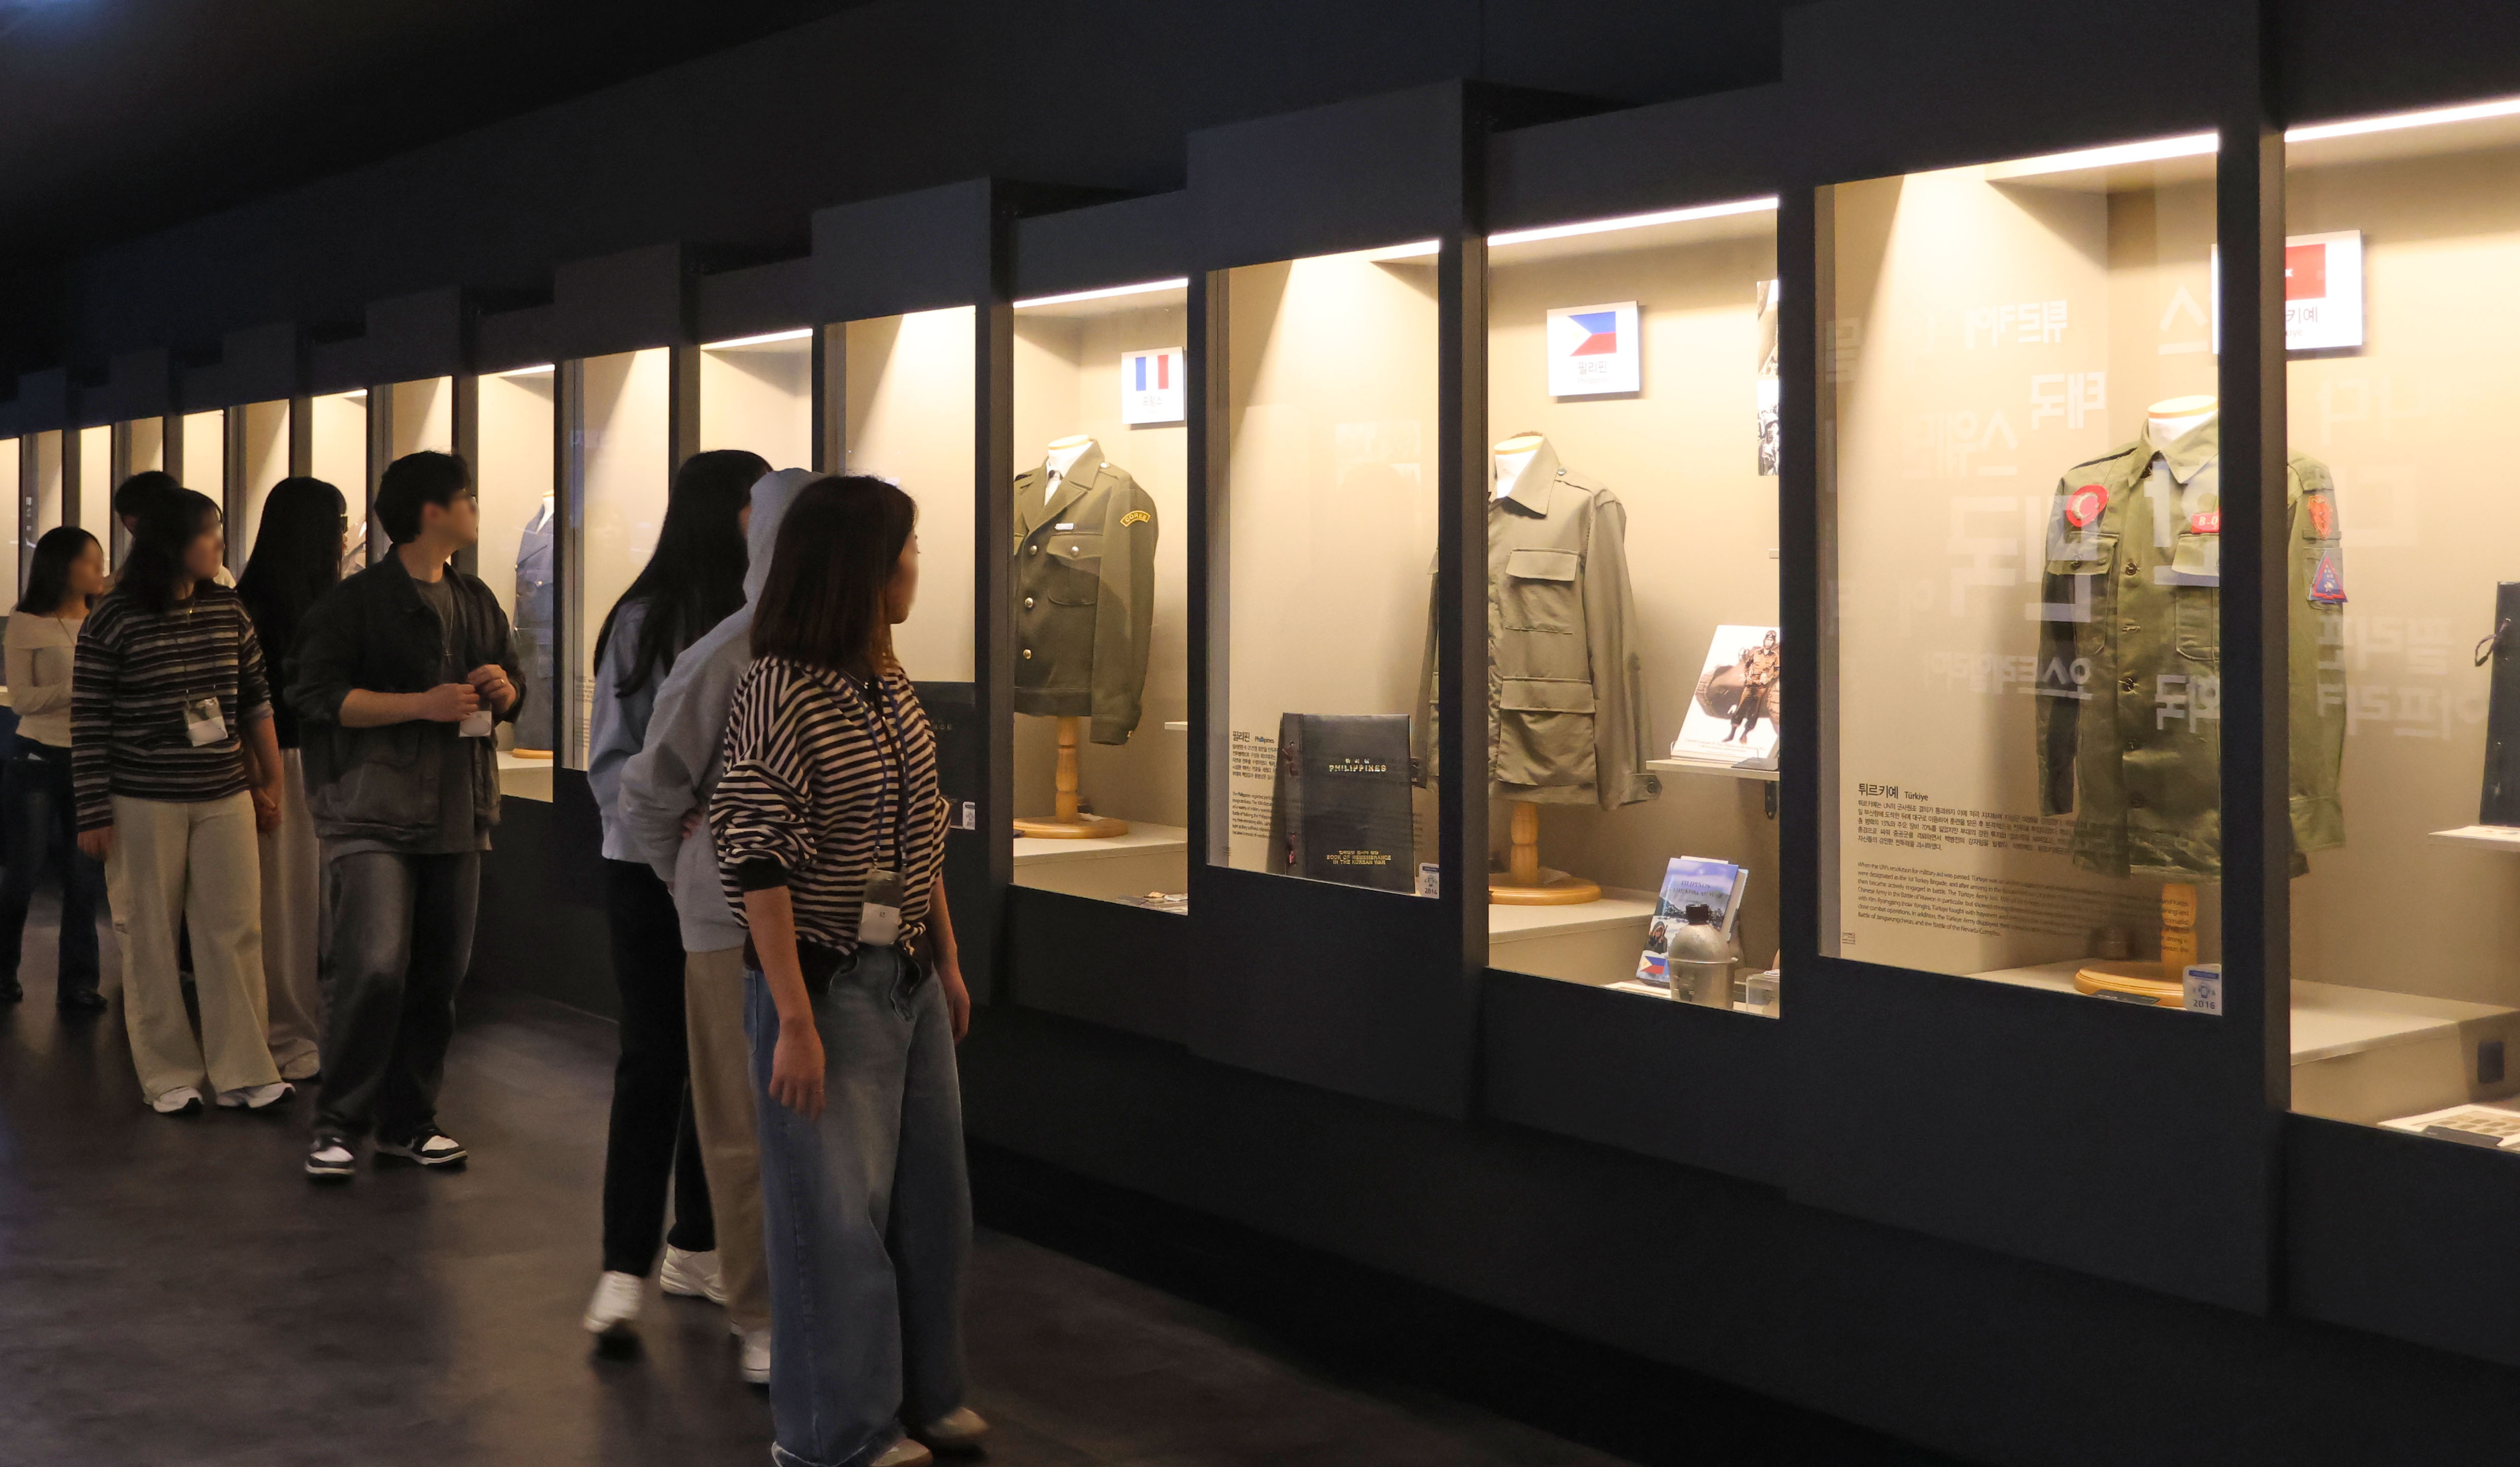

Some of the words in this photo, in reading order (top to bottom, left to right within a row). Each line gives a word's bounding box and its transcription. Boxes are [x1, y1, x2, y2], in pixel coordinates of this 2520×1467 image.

[2286, 306, 2318, 323] 키예
[1577, 360, 1606, 375] 필리핀
[1124, 512, 1147, 522] COREE
[1233, 731, 1250, 743] 필리핀
[1328, 764, 1387, 772] PHILIPPINES
[1858, 783, 1898, 799] 튀르키예
[1905, 792, 1928, 802] Türkiye
[1928, 816, 1949, 824] 이동하여
[1870, 872, 1893, 881] designated
[1906, 884, 1925, 894] engaged
[1977, 893, 1988, 901] Army
[1949, 907, 1964, 915] fought
